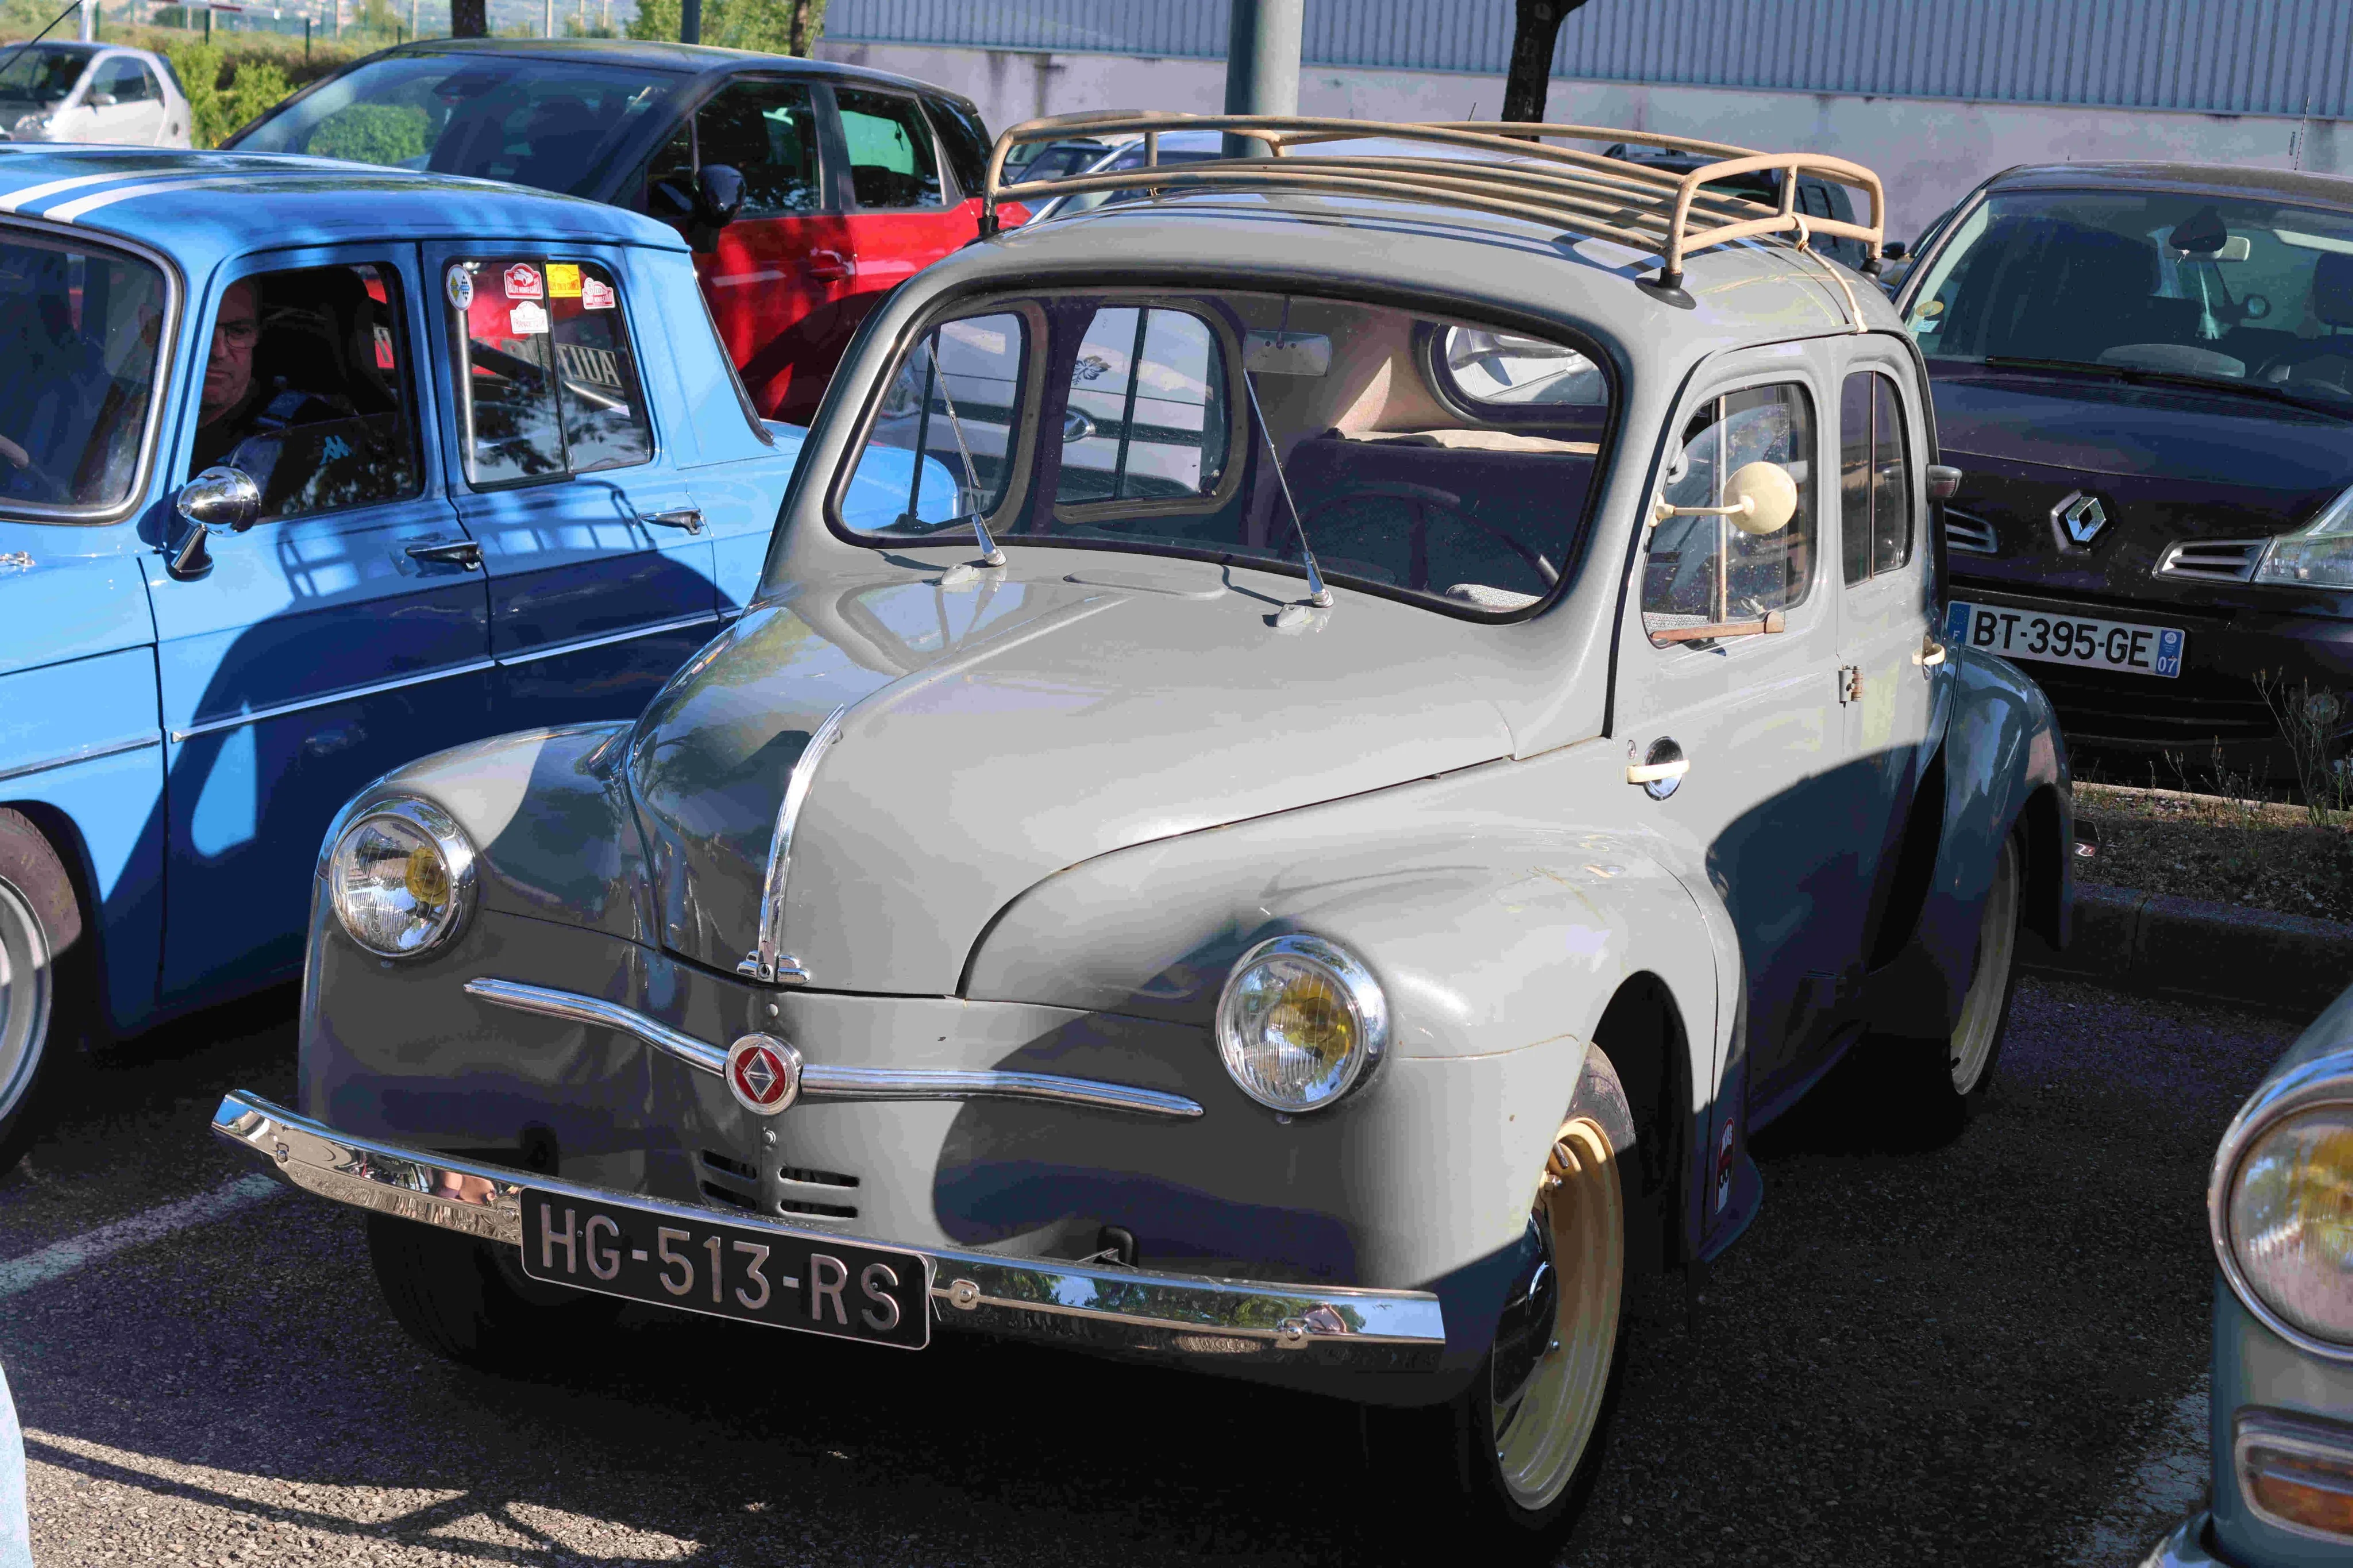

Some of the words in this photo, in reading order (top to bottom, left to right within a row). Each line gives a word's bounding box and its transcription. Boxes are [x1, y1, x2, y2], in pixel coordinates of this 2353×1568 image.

[1953, 629, 1961, 639] F
[1973, 611, 2153, 667] BT-395-GE
[2158, 656, 2178, 673] 07
[541, 1203, 900, 1331] HG-513-RS
